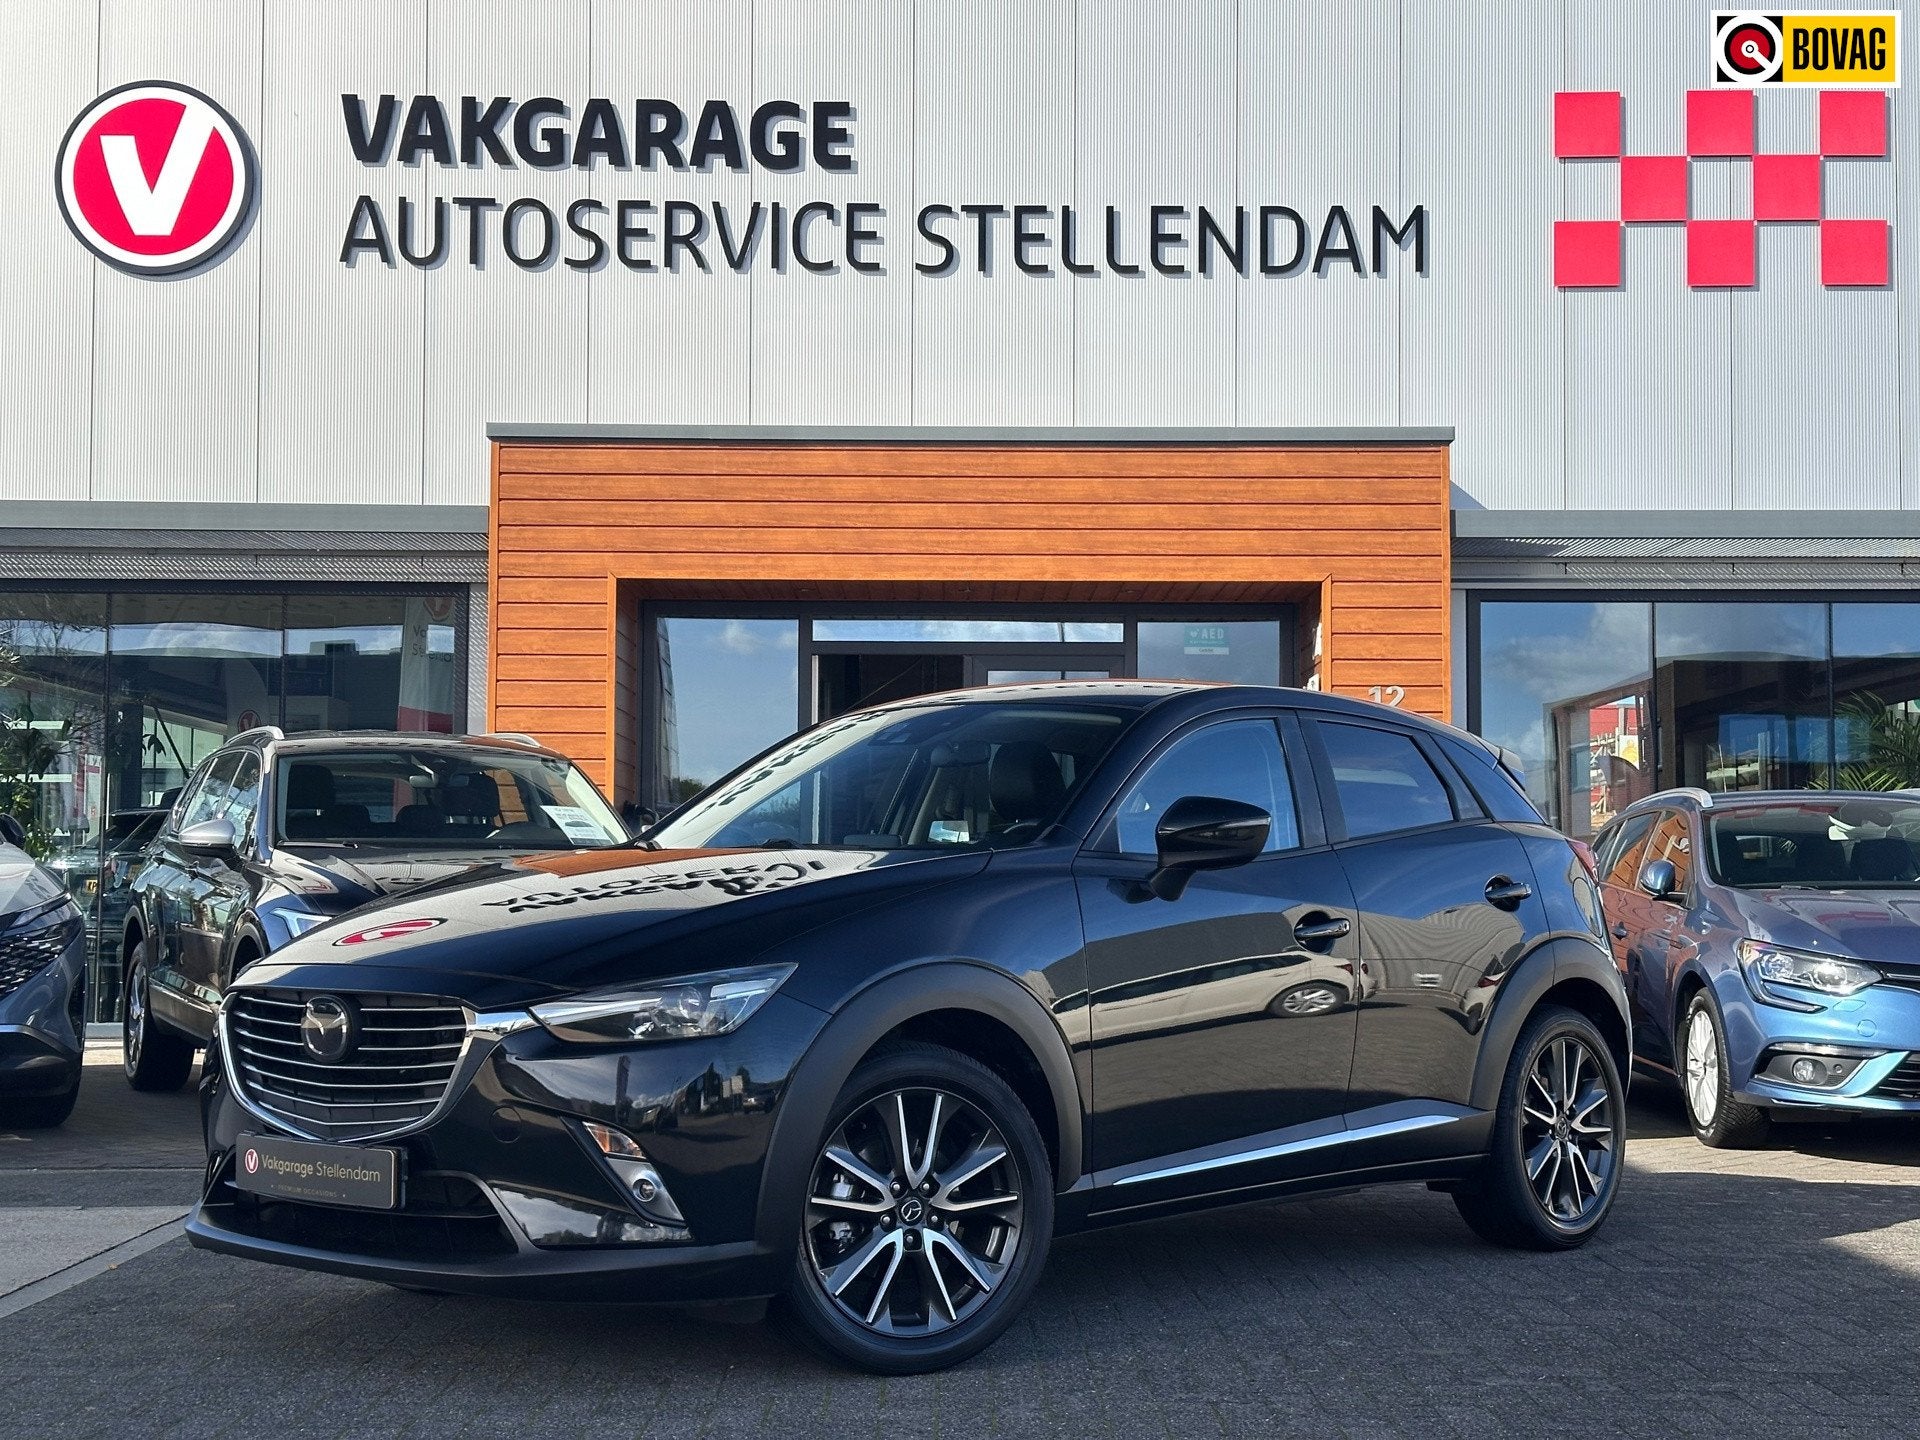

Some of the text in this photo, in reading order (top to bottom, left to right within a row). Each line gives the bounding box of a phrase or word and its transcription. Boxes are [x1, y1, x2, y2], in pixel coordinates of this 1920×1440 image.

[341, 94, 852, 172] VAKGARAGE
[340, 196, 1425, 277] AUTOSERVICE STELLENDAM
[1201, 629, 1224, 640] AED
[1369, 686, 1405, 707] 12
[261, 1154, 313, 1178] Vakgarage
[316, 1161, 381, 1182] Stellendam
